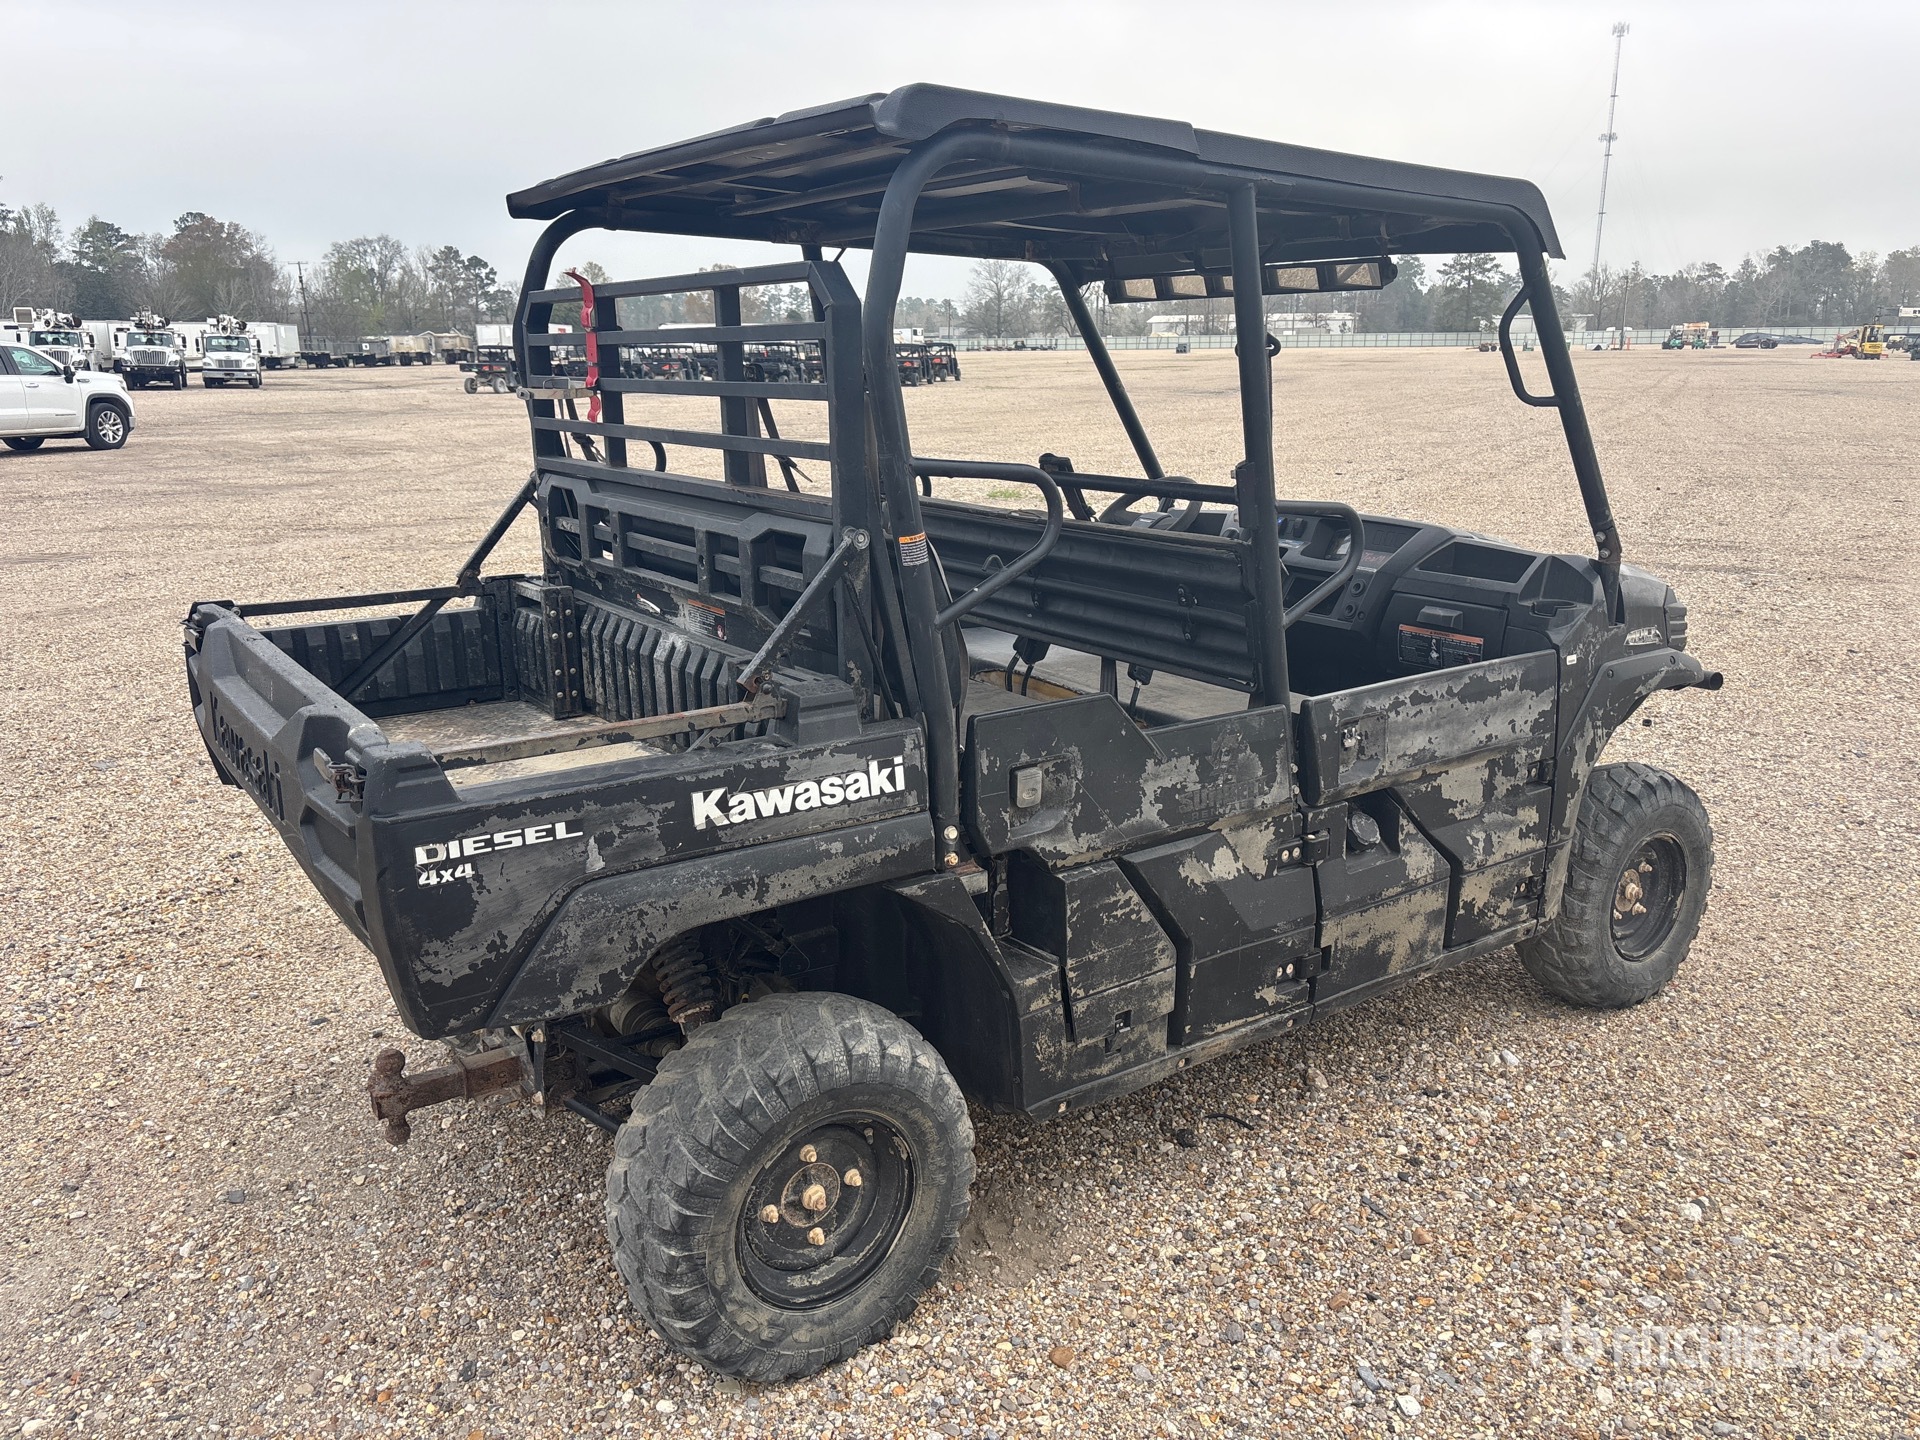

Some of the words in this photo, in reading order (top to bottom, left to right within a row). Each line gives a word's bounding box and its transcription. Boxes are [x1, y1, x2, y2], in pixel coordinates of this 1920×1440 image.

[209, 690, 286, 822] Kawasaki
[692, 756, 905, 830] Kawasaki
[415, 822, 583, 865] DIESEL
[418, 863, 476, 886] 4x4
